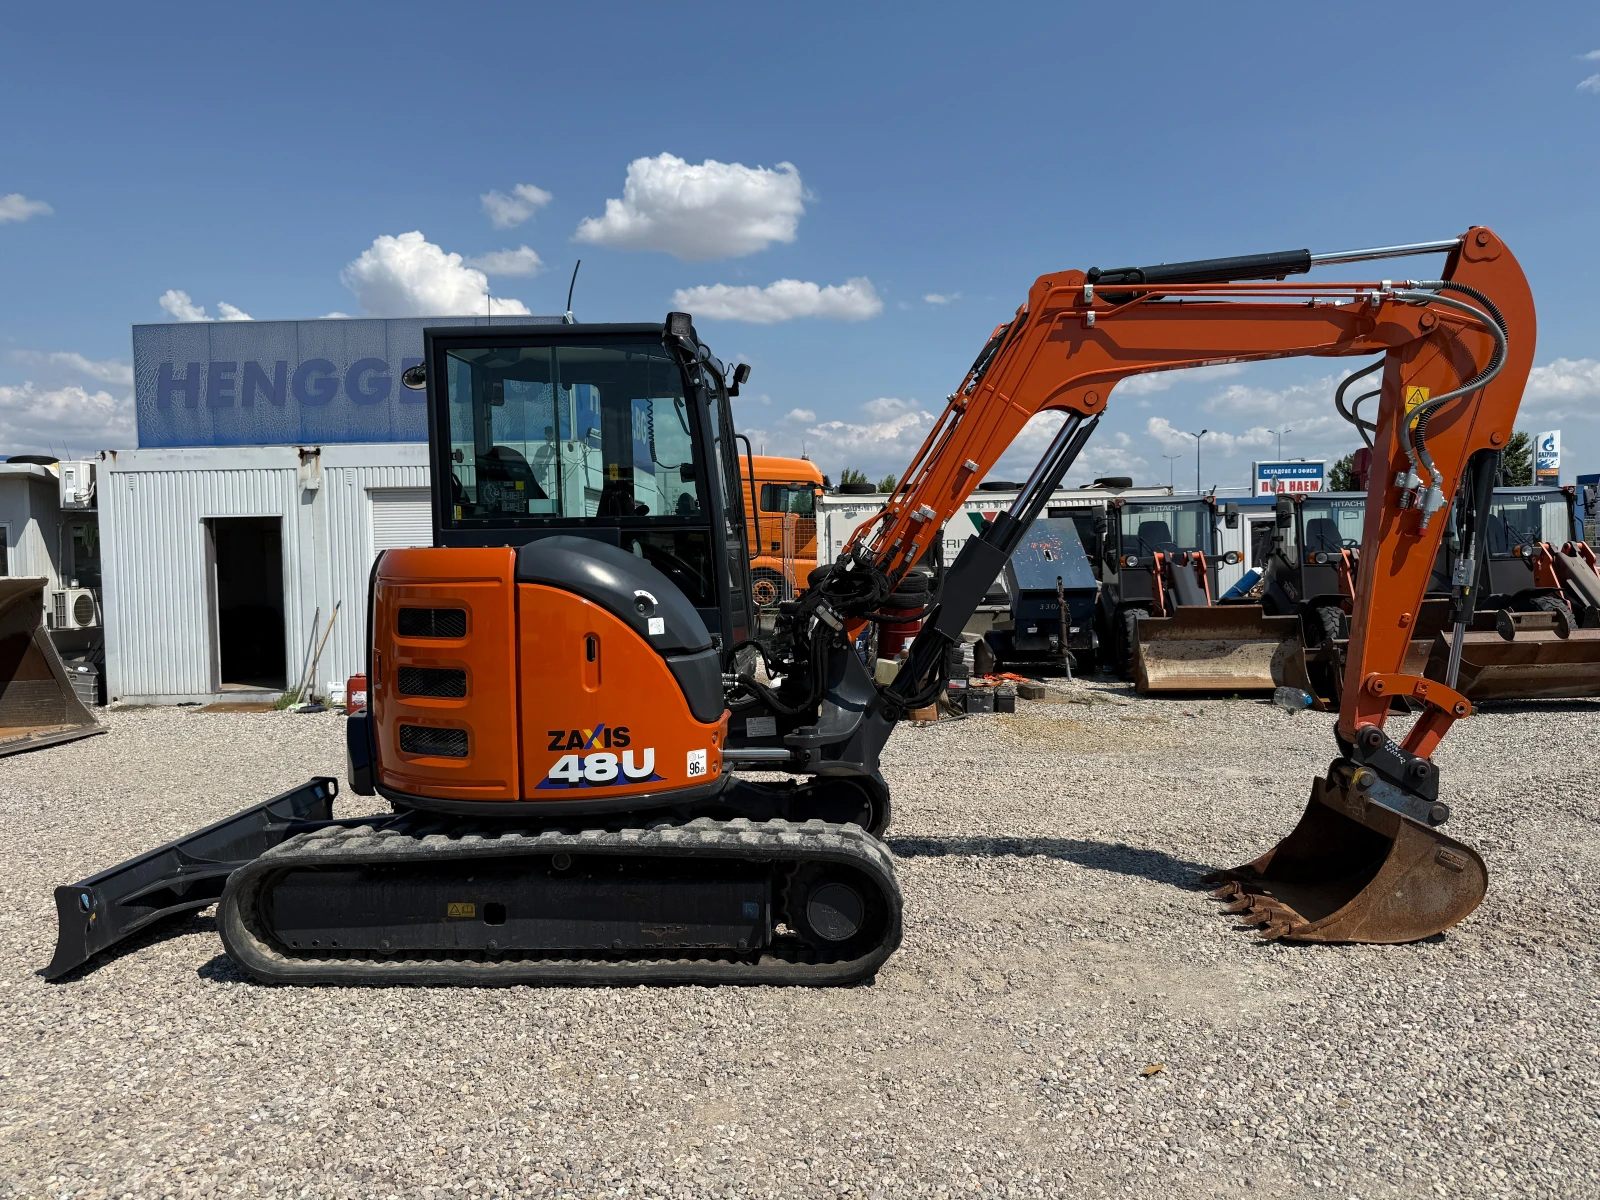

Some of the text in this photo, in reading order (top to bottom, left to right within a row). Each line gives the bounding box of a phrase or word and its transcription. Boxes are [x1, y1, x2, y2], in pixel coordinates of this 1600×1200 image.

[1262, 480, 1319, 493] ПД НАЕМ
[547, 723, 631, 751] ZAXIS
[548, 747, 655, 787] 48U
[690, 761, 700, 775] 96
